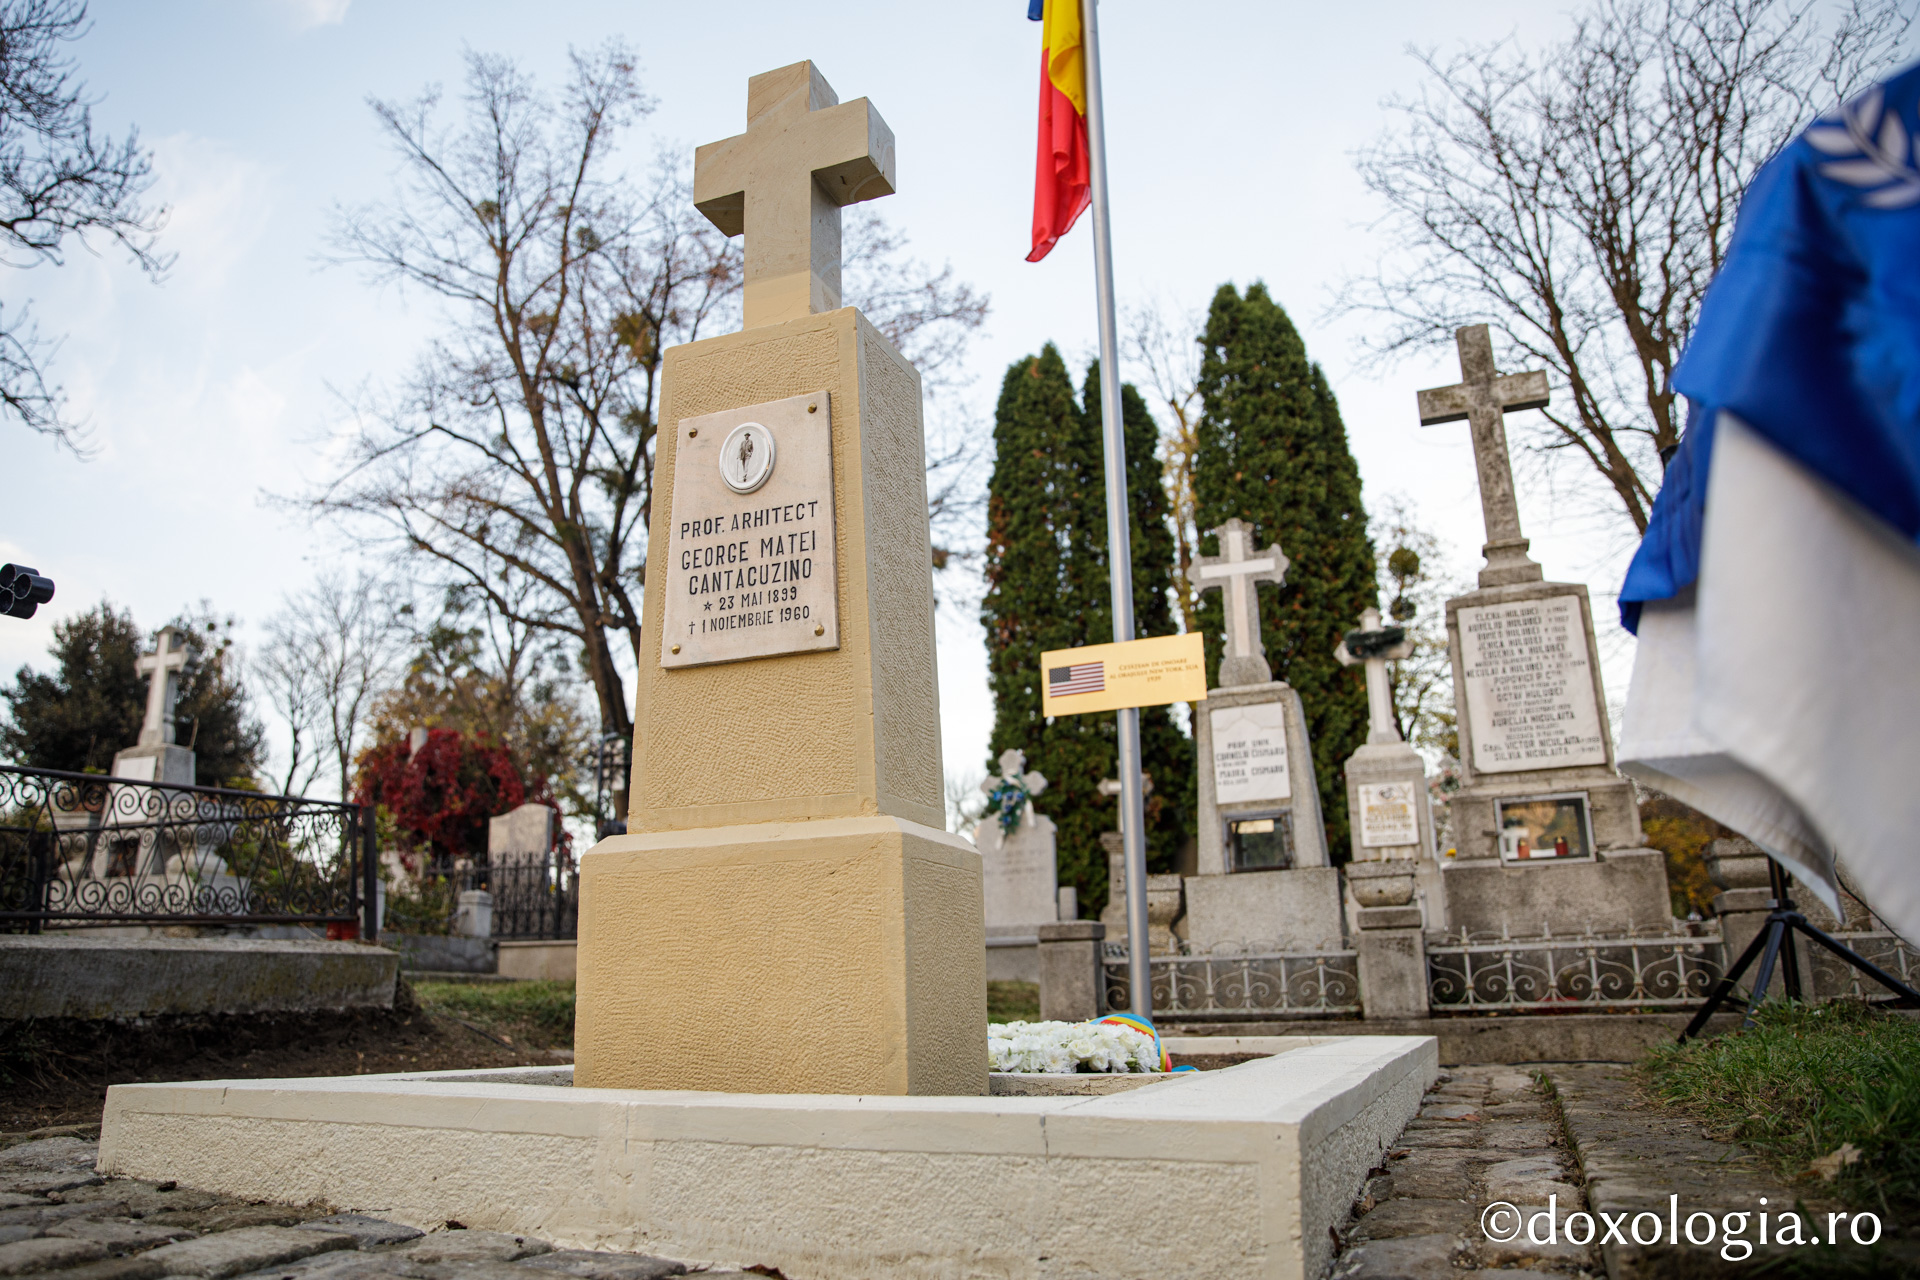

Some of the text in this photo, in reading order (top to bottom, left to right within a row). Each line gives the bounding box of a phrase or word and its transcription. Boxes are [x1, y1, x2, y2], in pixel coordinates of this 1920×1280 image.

[681, 500, 818, 539] PROF. ARHITECT
[682, 530, 815, 570] GEORGE MATEI
[689, 558, 812, 595] CANTACUZINO
[719, 586, 797, 611] 23 MAI 1899
[702, 605, 810, 633] 1 NOIEMBRIE 1960
